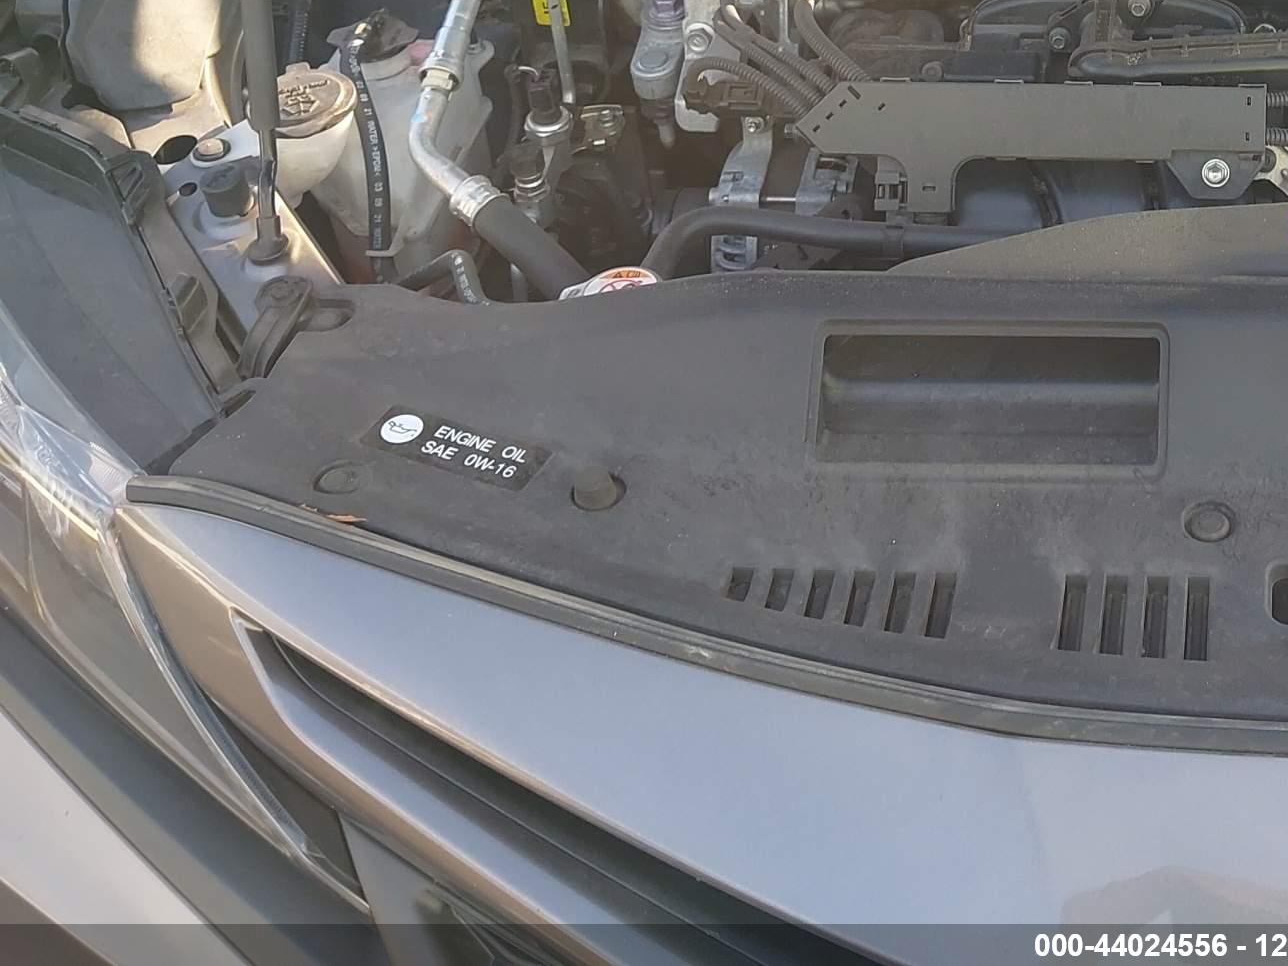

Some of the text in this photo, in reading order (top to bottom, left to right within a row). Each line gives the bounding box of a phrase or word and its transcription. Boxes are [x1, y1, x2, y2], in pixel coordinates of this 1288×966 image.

[421, 440, 517, 478] SAE 0W-16
[434, 425, 528, 463] ENGINE OIL
